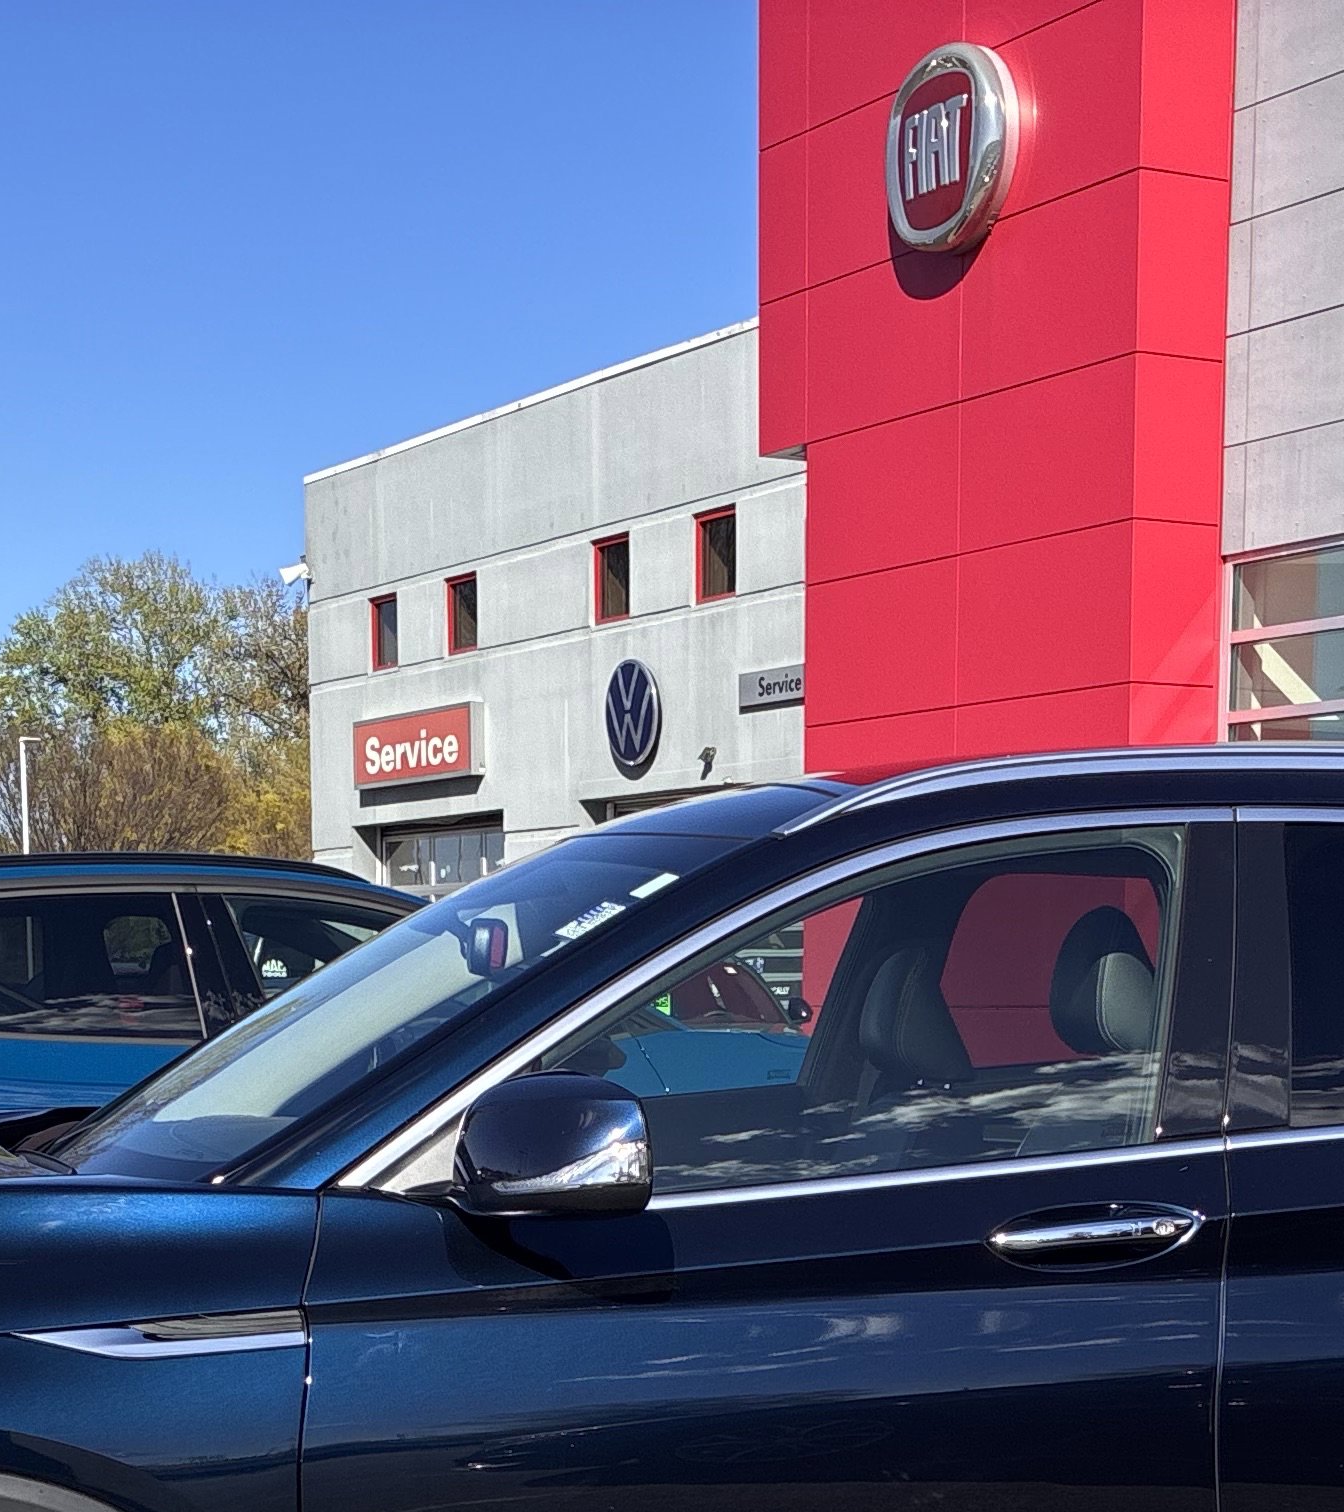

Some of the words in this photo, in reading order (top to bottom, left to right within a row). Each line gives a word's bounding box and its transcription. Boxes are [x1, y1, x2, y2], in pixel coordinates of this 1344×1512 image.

[904, 94, 968, 200] FIAT
[758, 673, 802, 697] Service
[365, 728, 459, 775] Service
